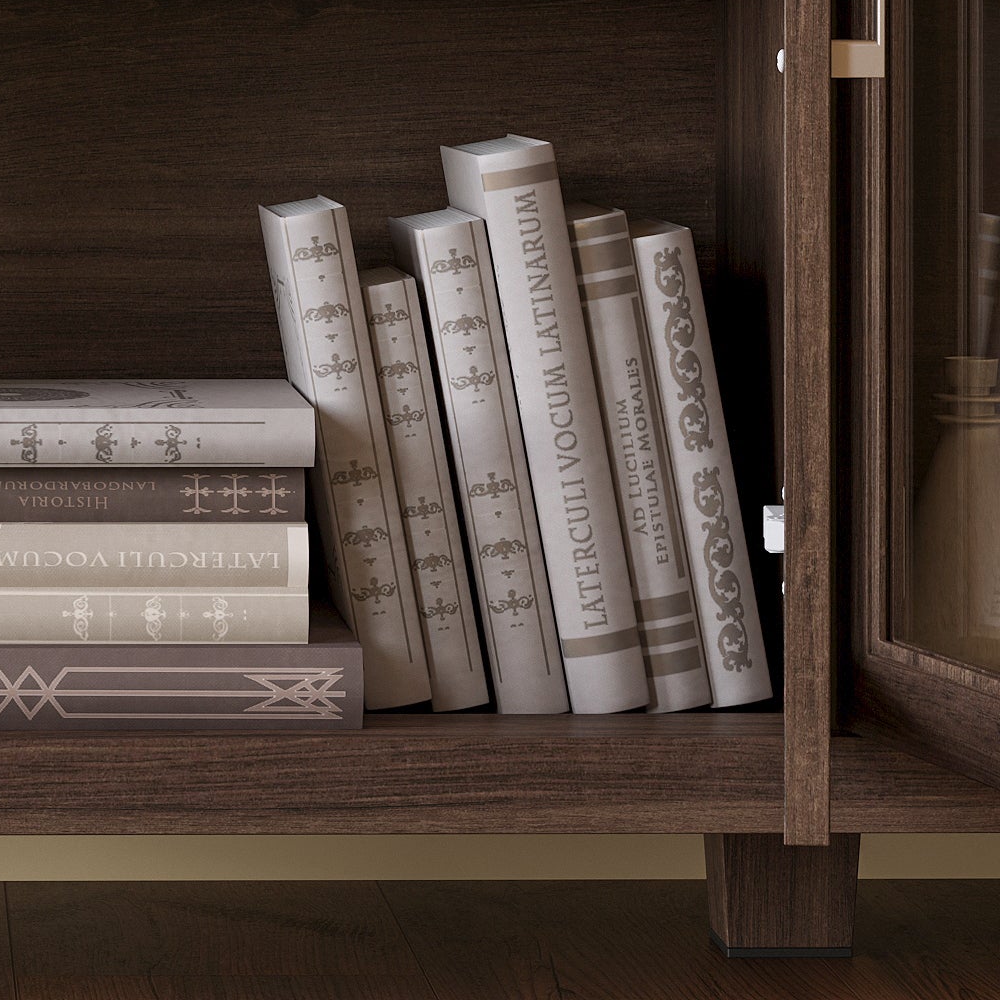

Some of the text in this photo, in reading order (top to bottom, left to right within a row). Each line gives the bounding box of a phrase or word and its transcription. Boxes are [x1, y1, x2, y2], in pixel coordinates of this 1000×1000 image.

[514, 189, 609, 631] LATERCULI VOCUM LATINARUM
[615, 398, 649, 537] AD LUCILIUM
[625, 357, 669, 565] EPISTULAE MORALES
[118, 550, 281, 570] LATERCULI
